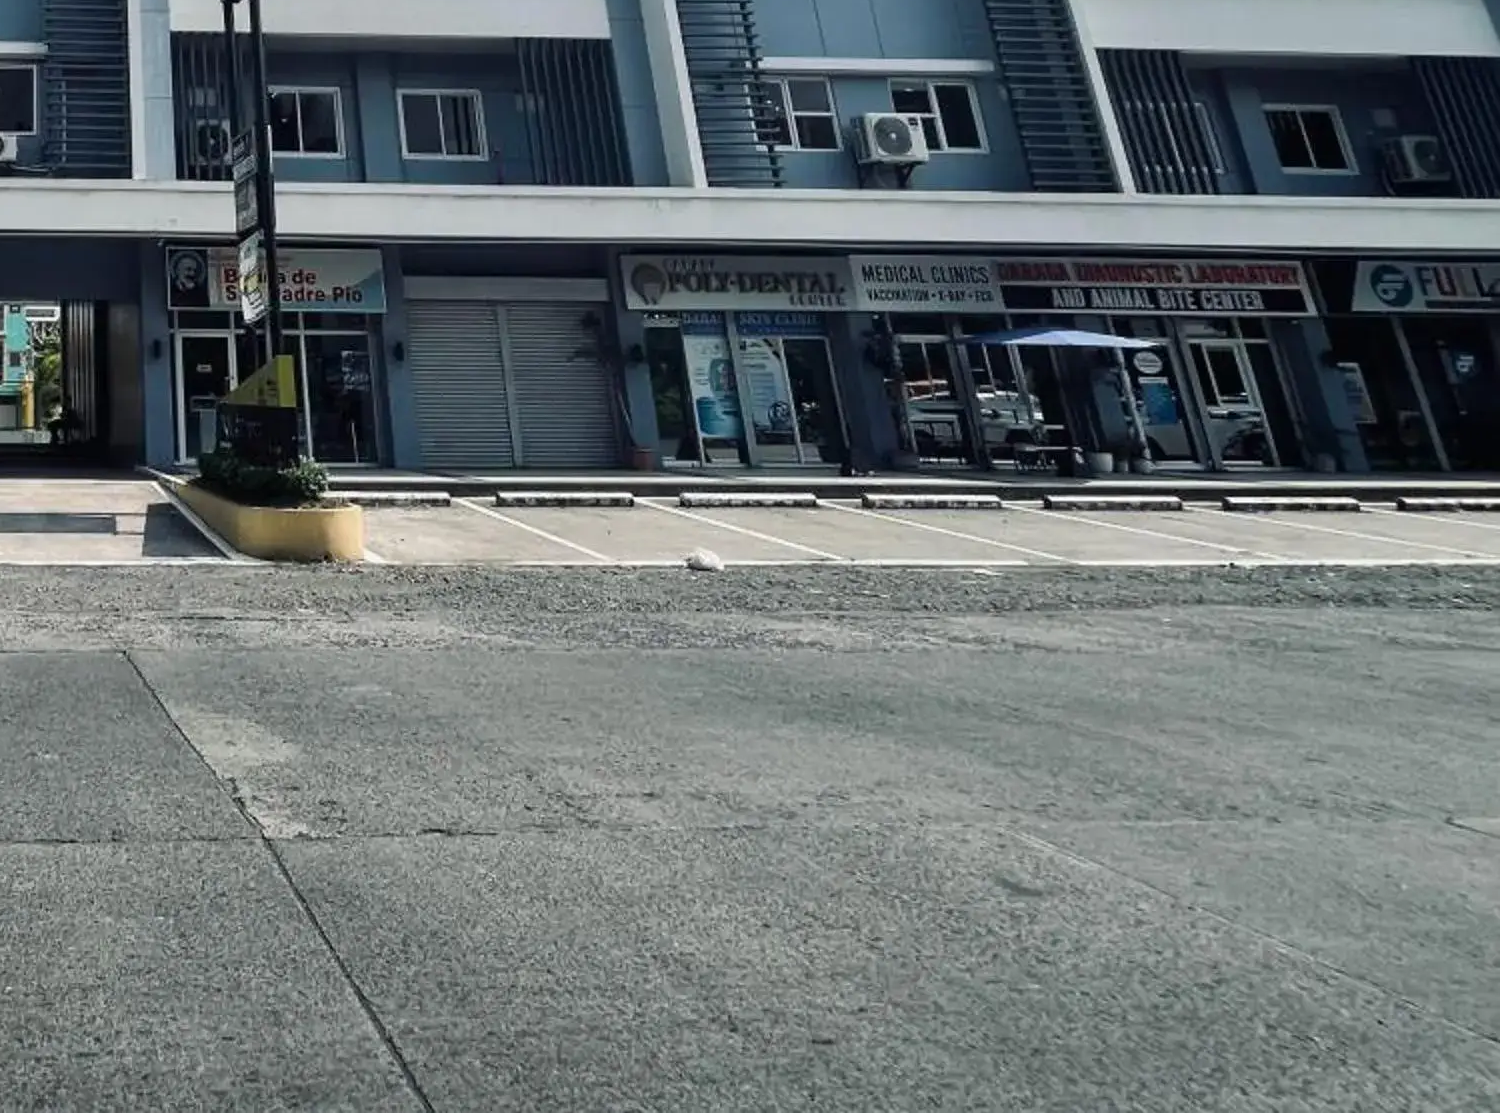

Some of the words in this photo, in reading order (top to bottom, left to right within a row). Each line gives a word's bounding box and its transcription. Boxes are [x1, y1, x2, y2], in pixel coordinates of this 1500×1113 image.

[292, 268, 317, 285] de
[861, 264, 930, 284] MEDICAL
[931, 265, 990, 284] CLINICS
[280, 286, 326, 302] adre
[332, 287, 364, 303] Pio
[1051, 288, 1086, 308] AND
[1089, 288, 1155, 309] ANIMAL
[1156, 290, 1198, 310] BITE
[1199, 290, 1266, 311] CENTER
